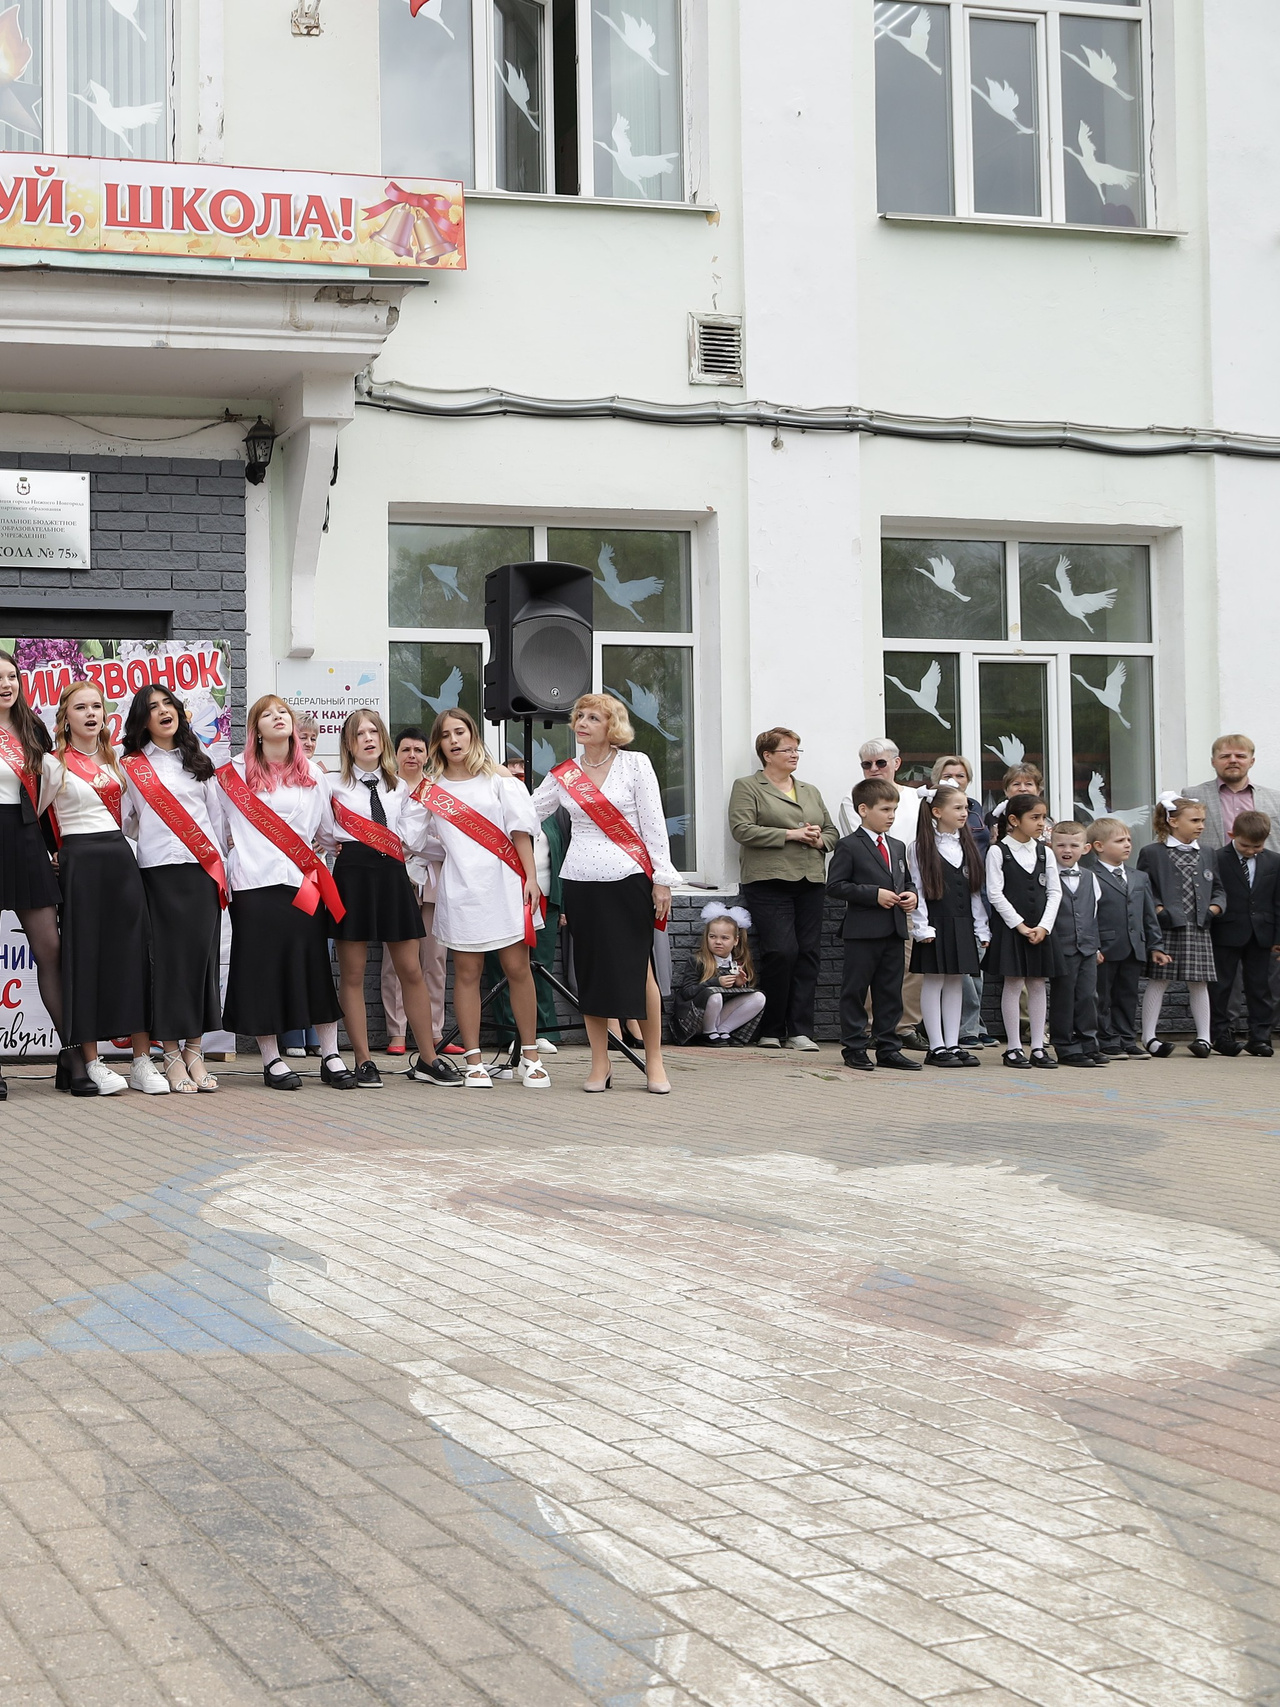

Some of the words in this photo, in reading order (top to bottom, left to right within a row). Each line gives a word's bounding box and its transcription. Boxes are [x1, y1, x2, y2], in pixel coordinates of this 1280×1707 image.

[103, 182, 354, 240] ШКОЛА!
[32, 519, 77, 527] БЮДЖЕТНОЕ
[37, 547, 55, 559] №
[58, 548, 78, 560] 75»
[85, 651, 223, 700] ЗВОНОК
[347, 697, 380, 706] ПРОЕКТ
[233, 785, 289, 846] Выпускница
[432, 793, 498, 846] Выпускница
[181, 823, 215, 859] 2025
